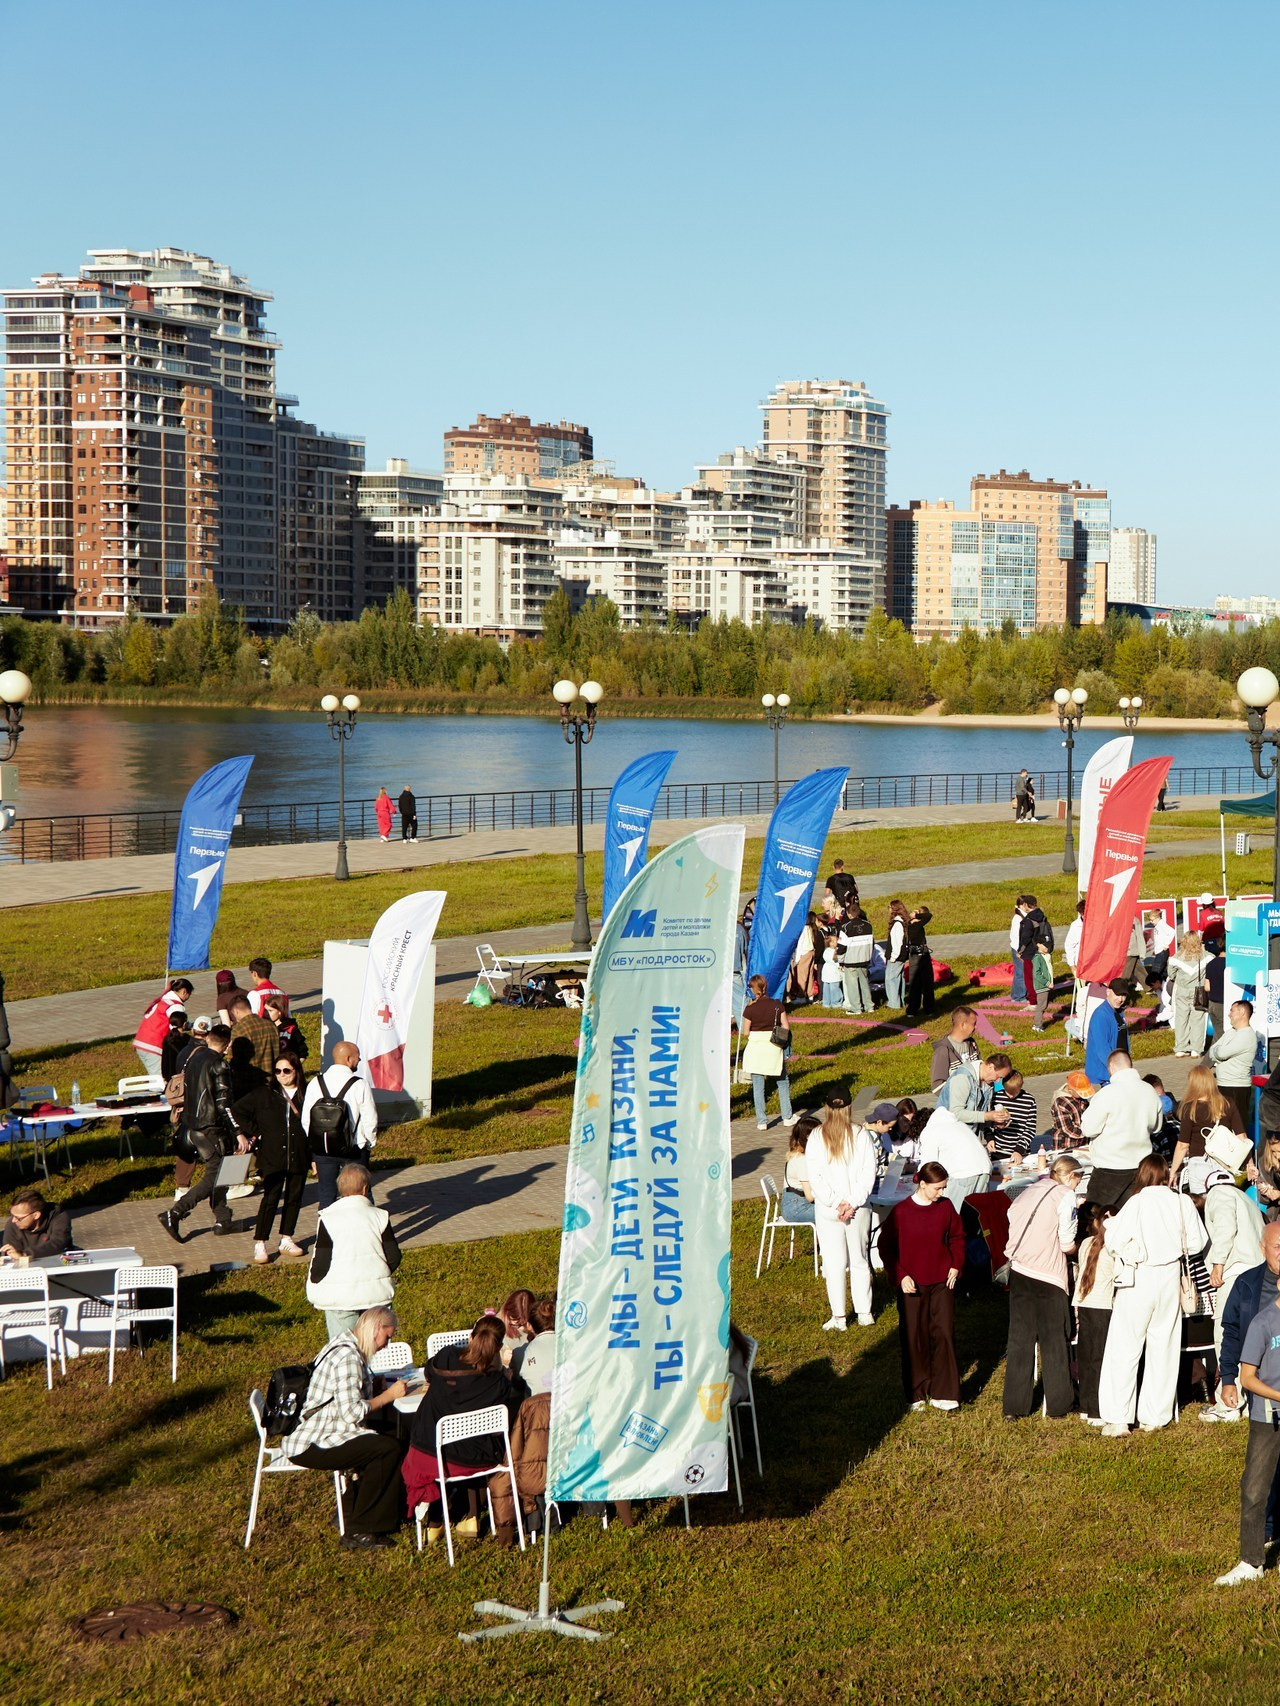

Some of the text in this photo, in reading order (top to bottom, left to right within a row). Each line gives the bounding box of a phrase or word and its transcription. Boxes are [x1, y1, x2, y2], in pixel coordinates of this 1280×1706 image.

[190, 846, 225, 857] Первые
[777, 861, 813, 878] Первые
[1105, 849, 1138, 862] Первые
[390, 929, 412, 992] КРАСНЫЙ КРЕСТ
[611, 954, 711, 966] МБУ «ПОДРОСТОК»
[649, 1005, 681, 1108] НАМИ!
[610, 1028, 640, 1161] КАЗАНИ,
[650, 1120, 678, 1166] ЗА
[611, 1178, 644, 1260] ДЕТИ
[647, 1178, 684, 1306] СЛЕДУЙ
[608, 1294, 641, 1349] МЫ
[654, 1340, 684, 1390] ТЫ
